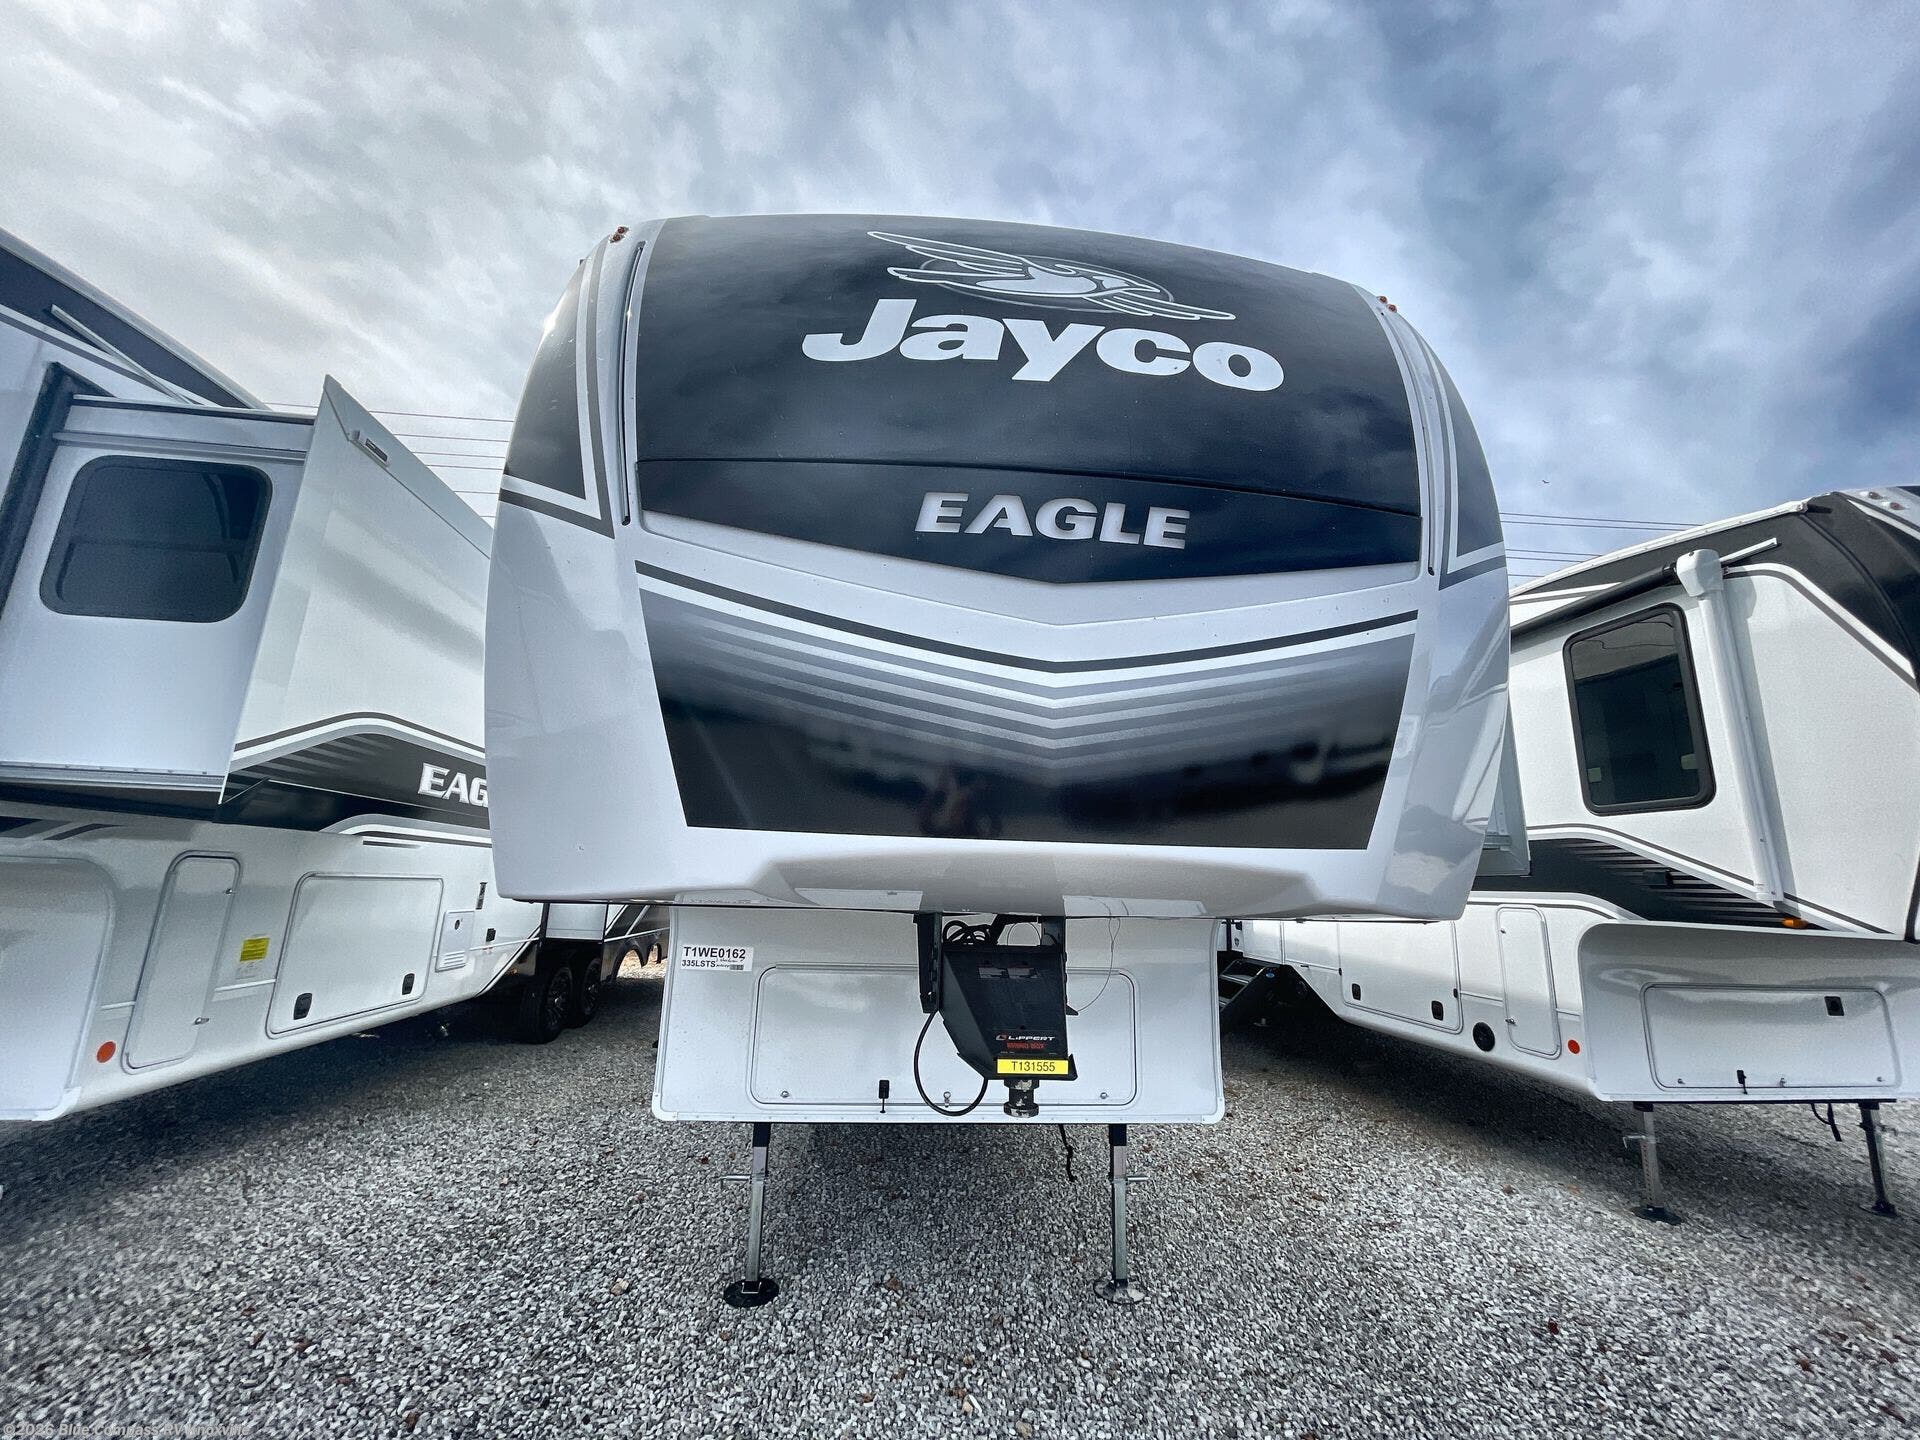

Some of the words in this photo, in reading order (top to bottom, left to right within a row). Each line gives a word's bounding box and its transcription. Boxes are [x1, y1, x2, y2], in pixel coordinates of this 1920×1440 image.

[802, 298, 1284, 391] Jayco
[915, 492, 1190, 549] EAGLE
[683, 946, 746, 959] T1WE0162
[681, 959, 716, 968] 335LSTS
[1011, 1061, 1056, 1072] T131555
